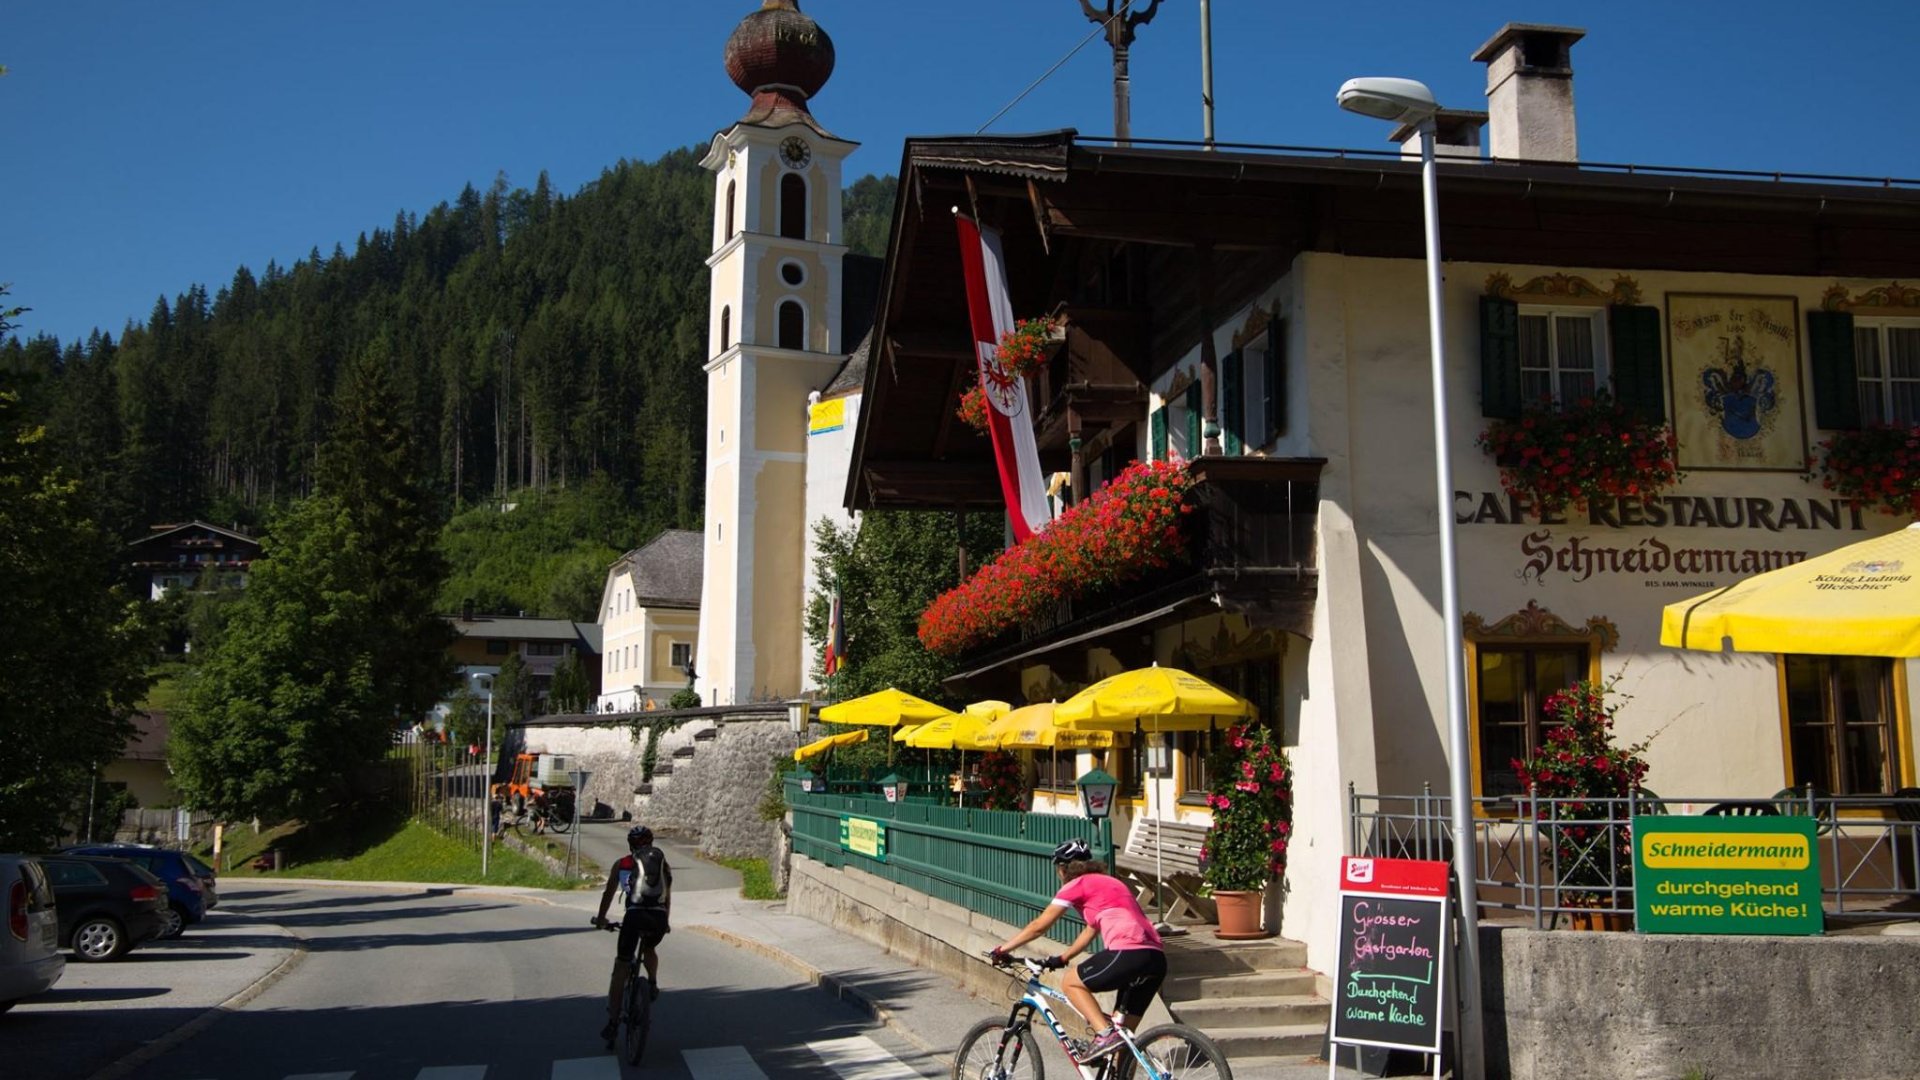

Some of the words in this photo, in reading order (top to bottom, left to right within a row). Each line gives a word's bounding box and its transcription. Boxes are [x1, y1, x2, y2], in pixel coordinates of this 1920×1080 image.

[1588, 495, 1868, 532] RESTAURANT
[1649, 842, 1804, 858] Schneidermann
[1656, 880, 1799, 898] durchgehend
[1650, 903, 1725, 916] warme
[1731, 902, 1808, 918] Küche!
